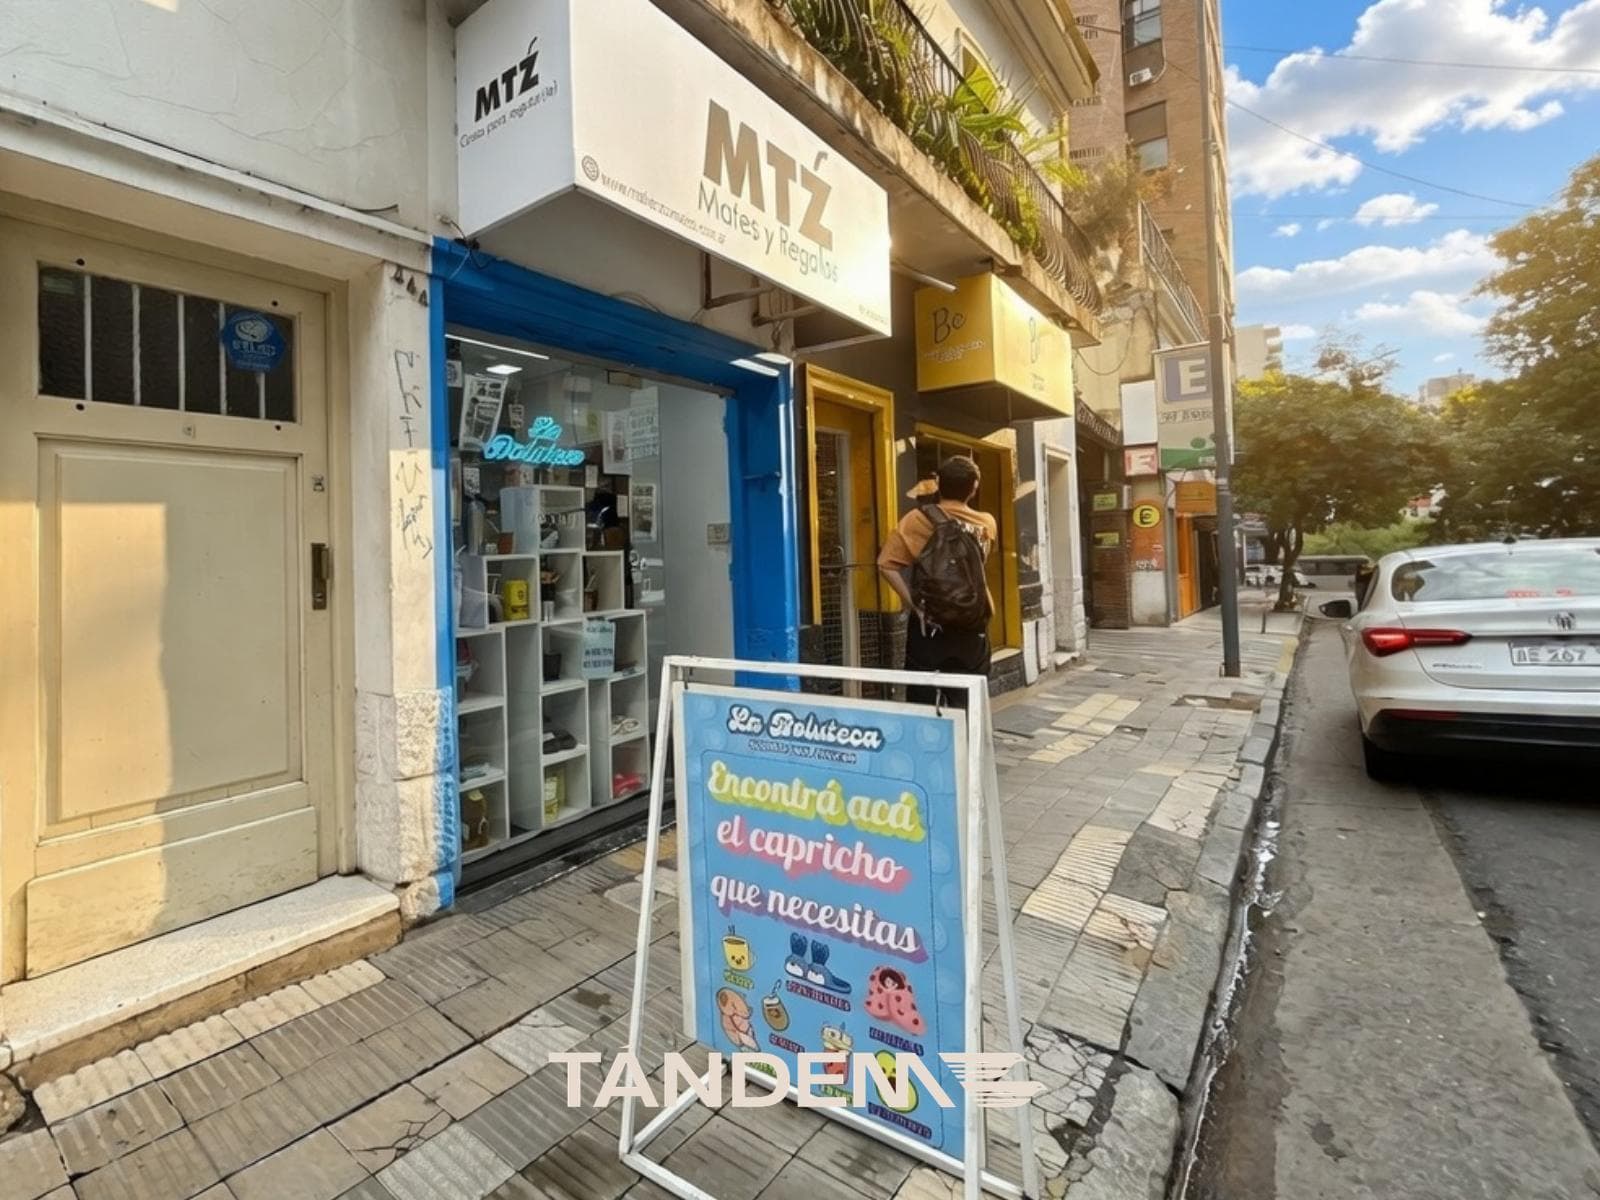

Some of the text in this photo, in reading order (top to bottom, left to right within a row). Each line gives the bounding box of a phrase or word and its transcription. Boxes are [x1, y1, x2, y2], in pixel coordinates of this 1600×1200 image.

[697, 179, 759, 241] Mates
[764, 226, 775, 256] y
[779, 224, 839, 284] Regalos
[1177, 357, 1207, 397] E
[1547, 648, 1587, 663] 267
[707, 760, 922, 837] Encontrá acá
[716, 815, 904, 884] el capricho
[710, 875, 922, 953] que necesitas
